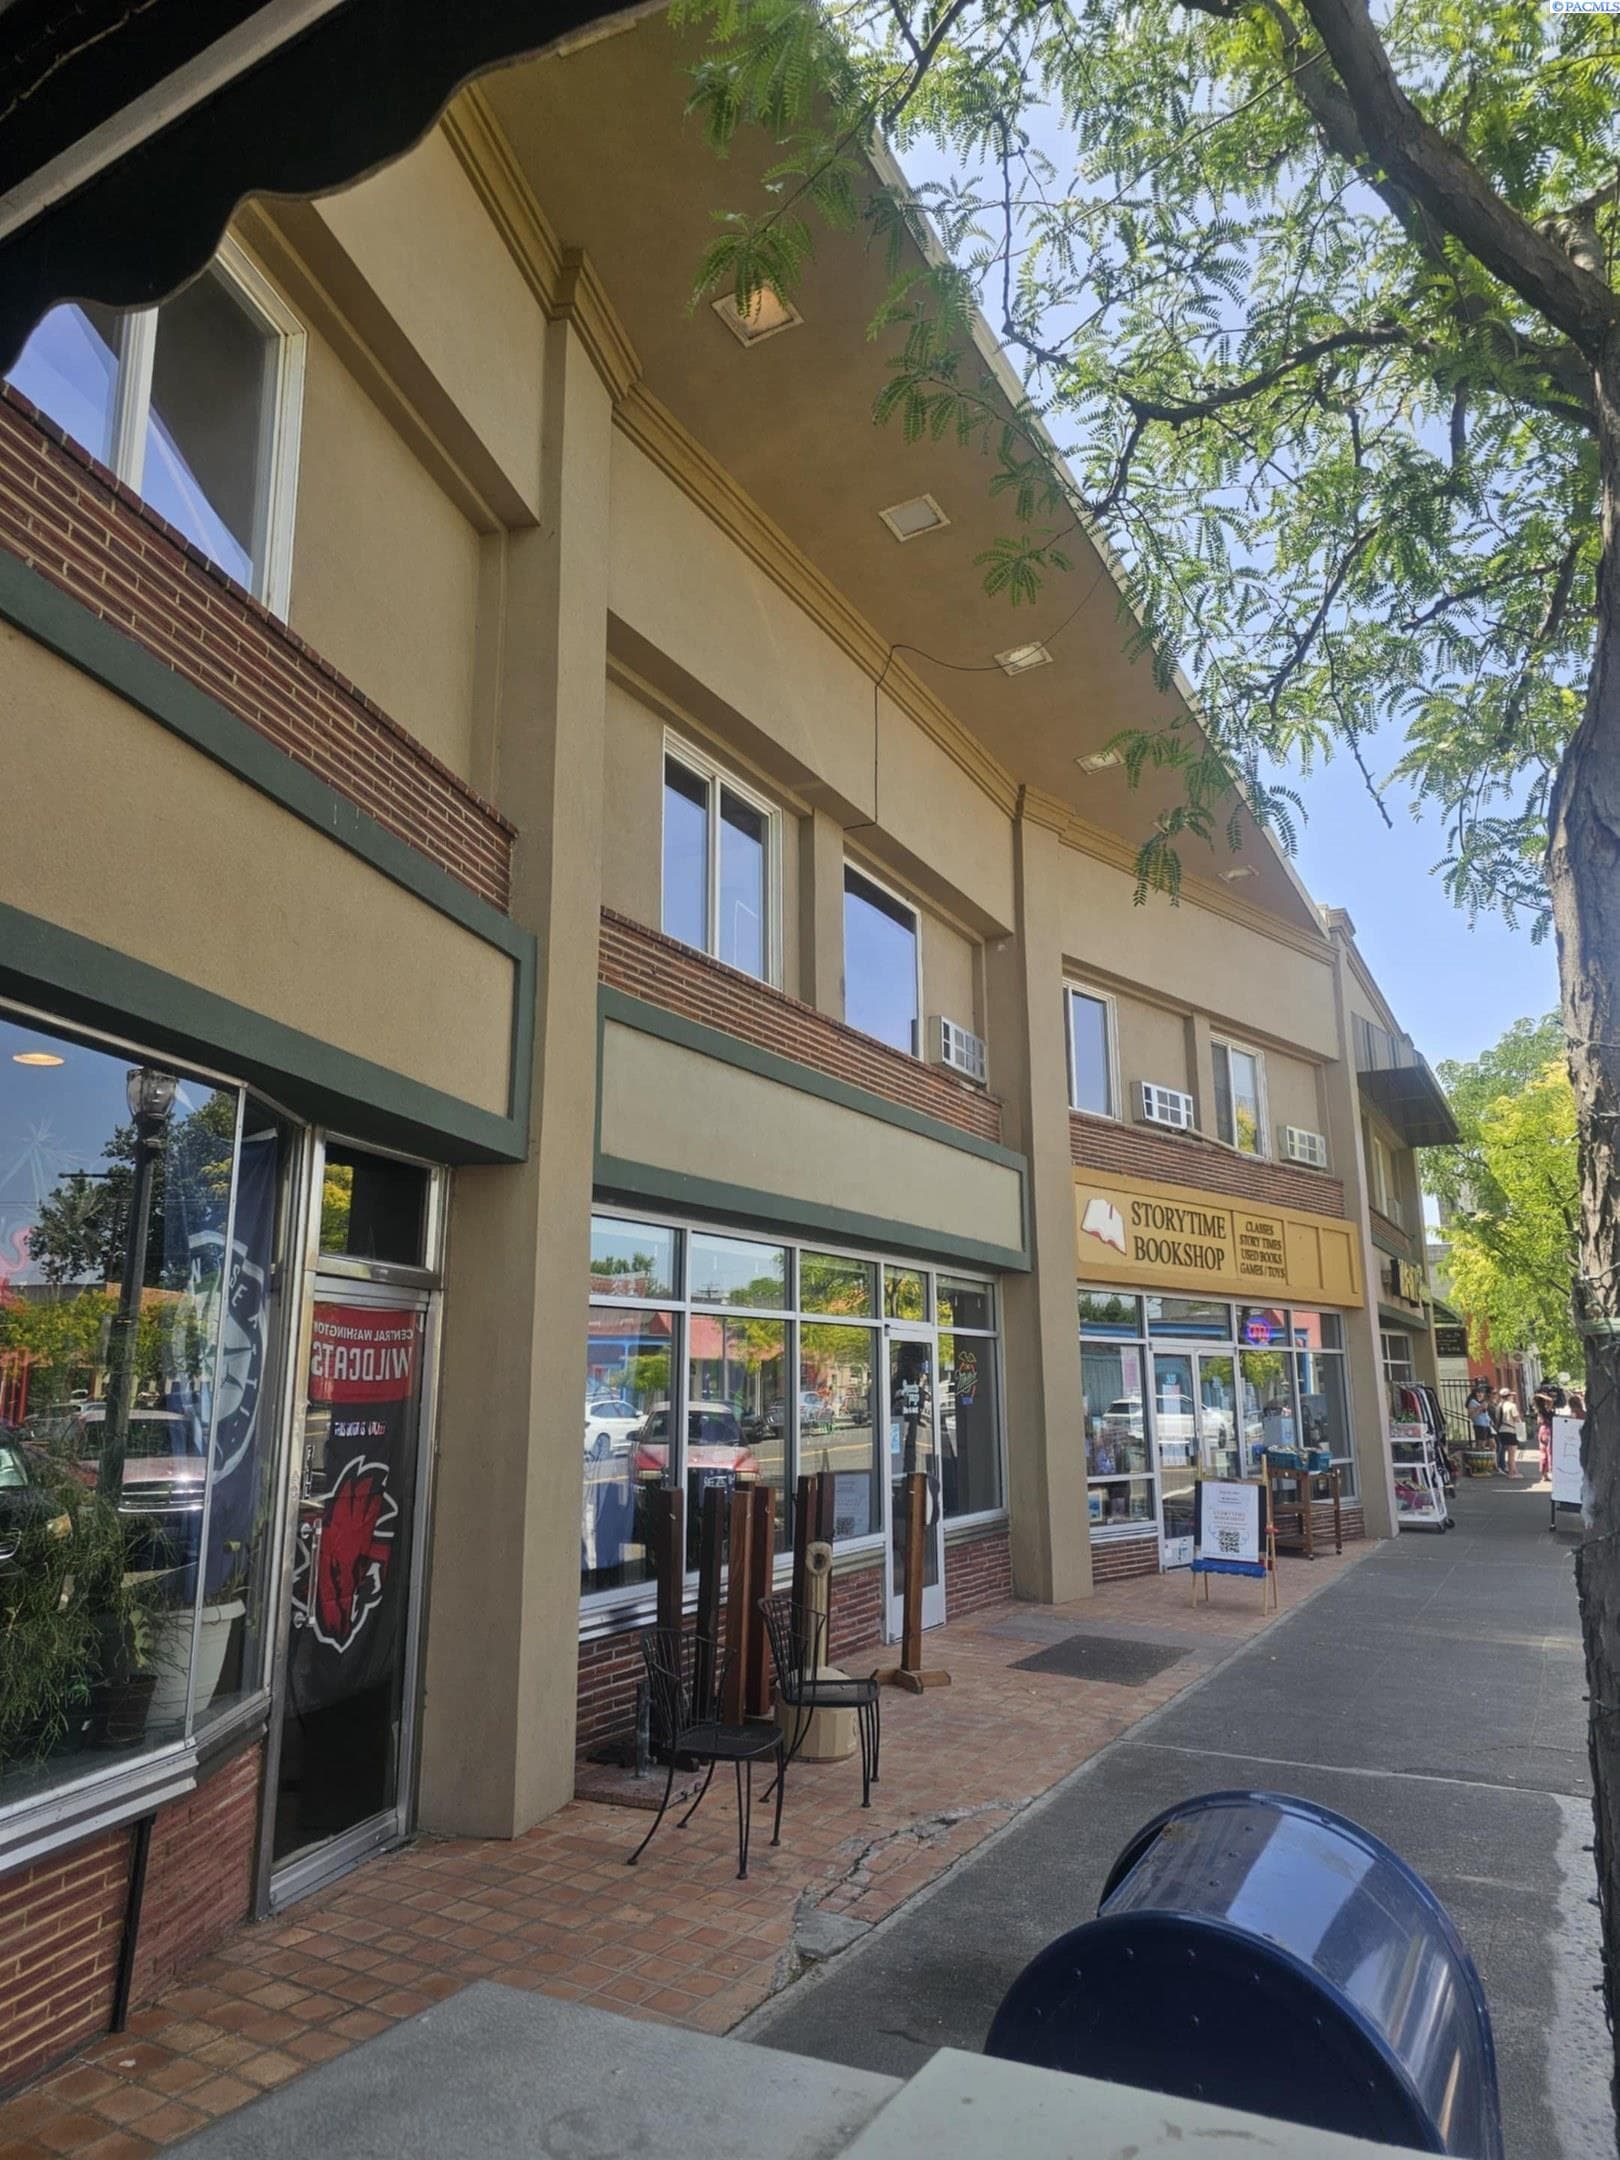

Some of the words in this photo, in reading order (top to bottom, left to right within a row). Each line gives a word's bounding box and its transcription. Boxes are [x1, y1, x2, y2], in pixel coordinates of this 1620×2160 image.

[1131, 1200, 1226, 1240] STORYTIME
[1246, 1221, 1274, 1236] CLASSES
[1240, 1234, 1260, 1248] STORY
[1262, 1238, 1282, 1251] TIMES
[1133, 1235, 1225, 1271] BOOKSHOP
[1241, 1248, 1259, 1261] USED
[1260, 1251, 1282, 1264] BOOKS
